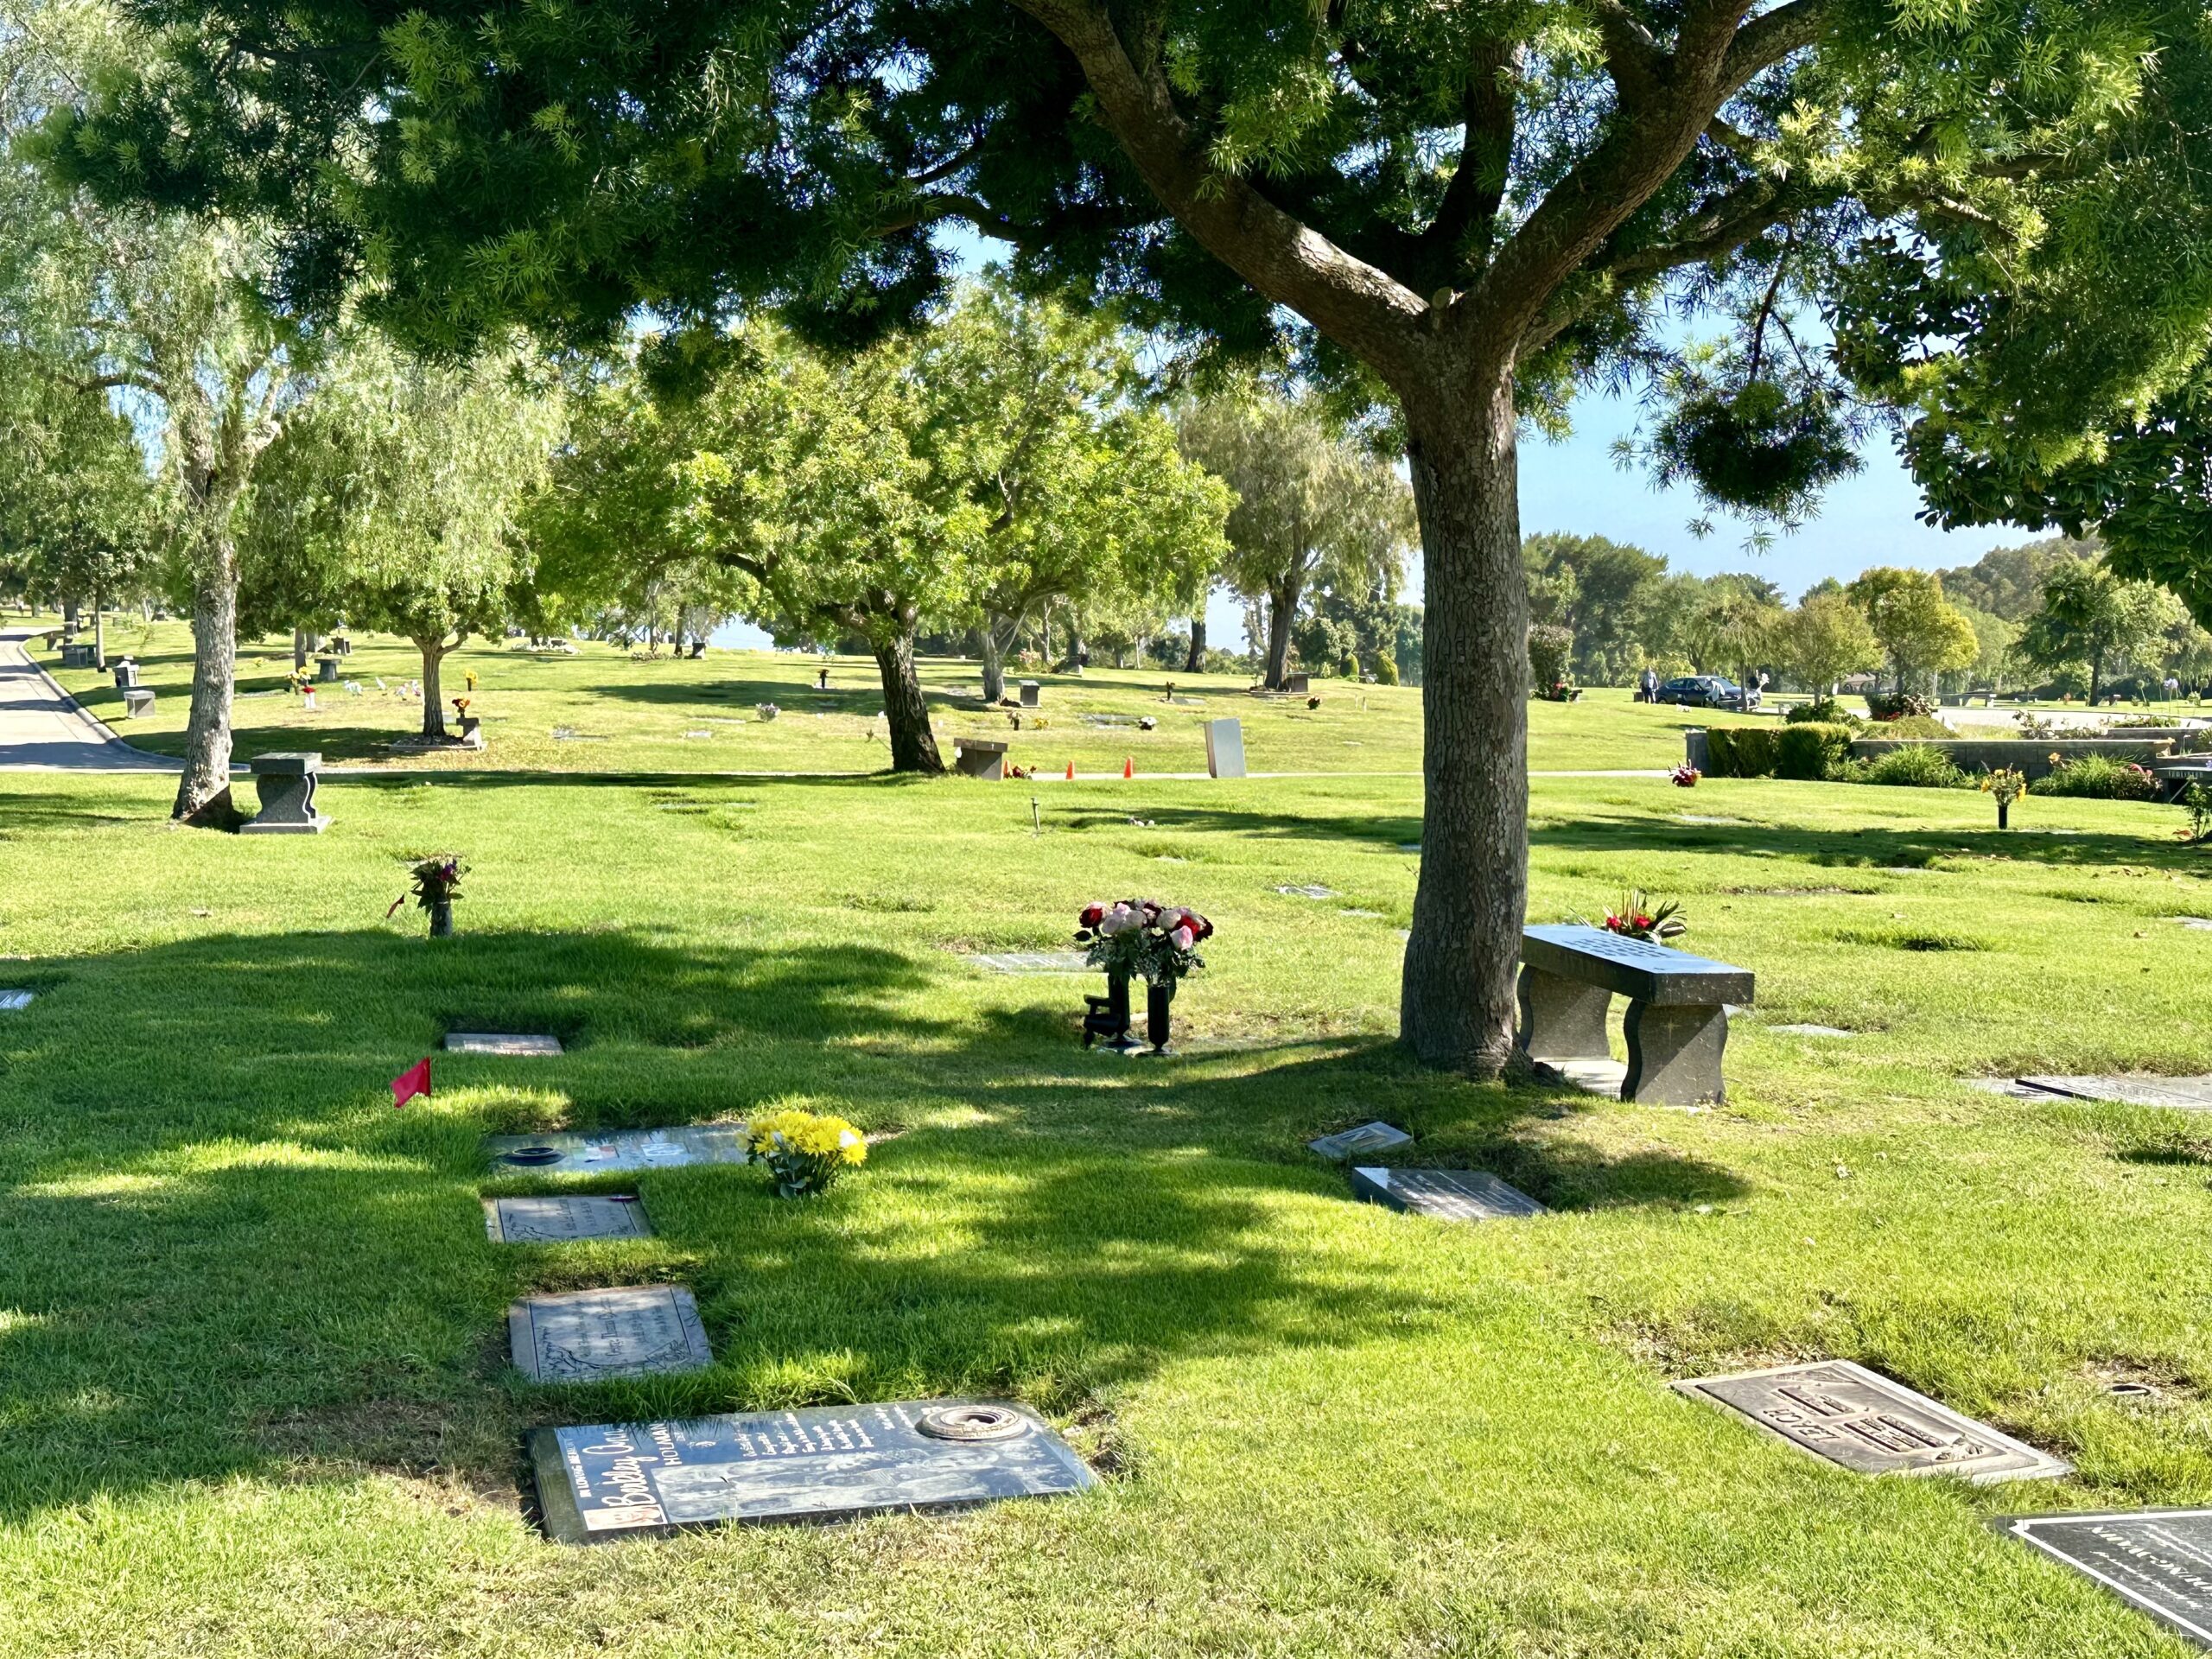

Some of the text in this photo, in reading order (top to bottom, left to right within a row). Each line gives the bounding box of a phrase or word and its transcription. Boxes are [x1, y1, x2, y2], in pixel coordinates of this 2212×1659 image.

[1763, 1408, 1840, 1440] LEACH
[649, 1423, 682, 1465] HOLMAN
[572, 1465, 589, 1489] LOVING
[601, 1456, 658, 1507] Berkley
